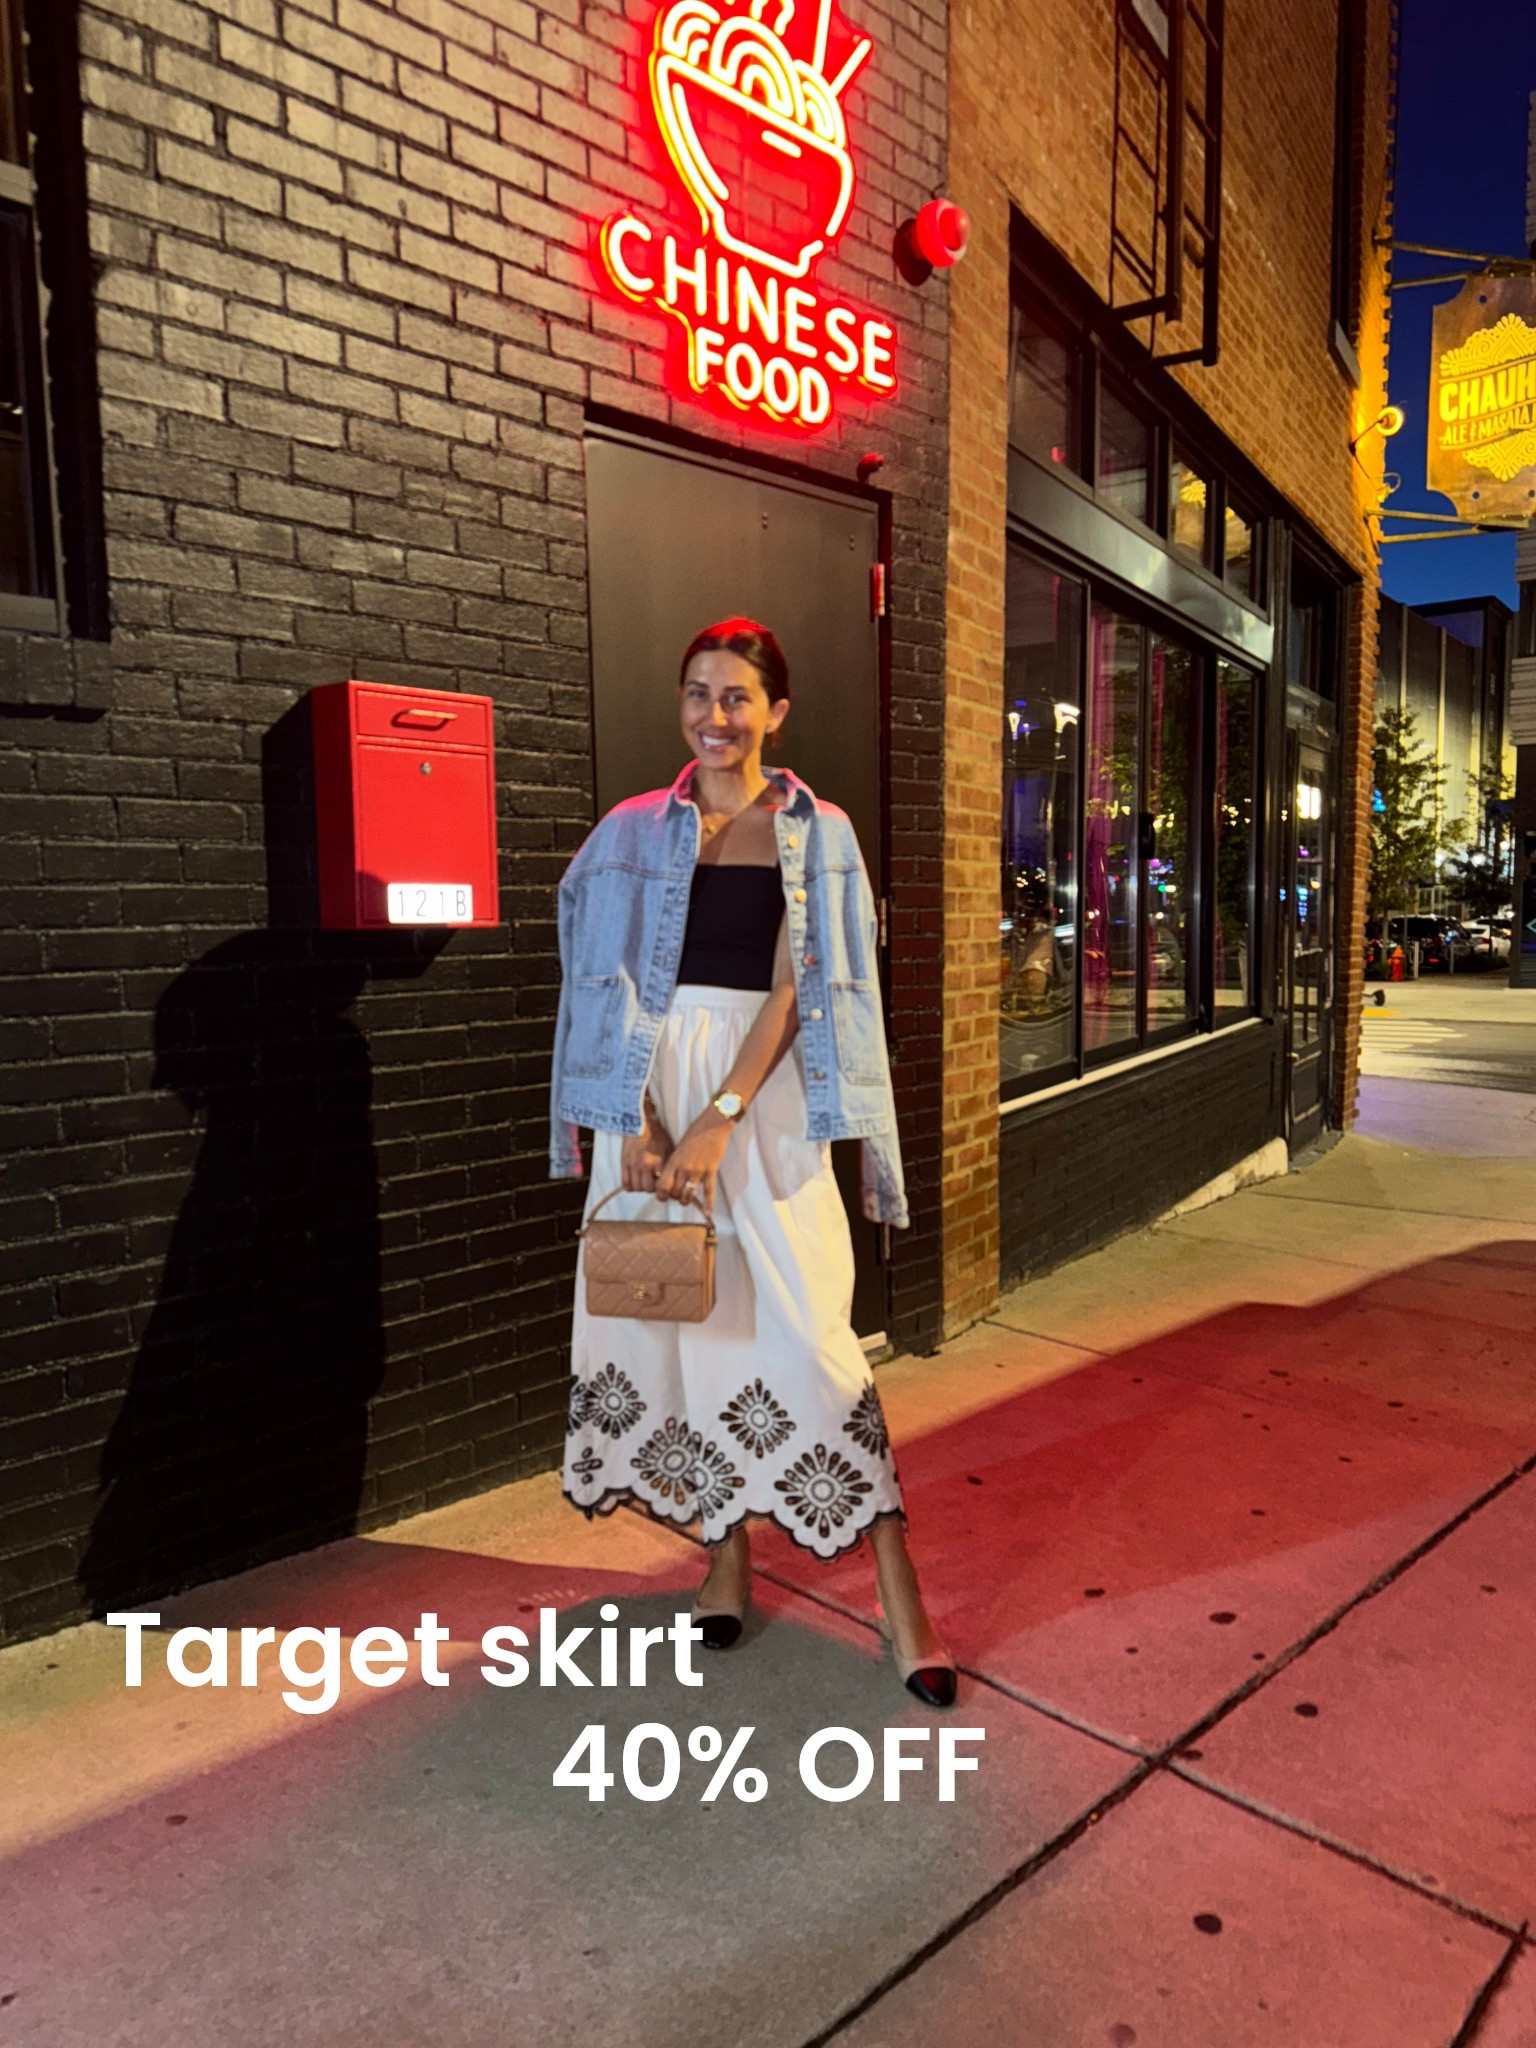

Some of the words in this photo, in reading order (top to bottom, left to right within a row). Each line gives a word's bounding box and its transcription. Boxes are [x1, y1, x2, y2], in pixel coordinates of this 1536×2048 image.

[608, 216, 894, 388] CHINESE
[695, 327, 830, 424] FOOD
[1443, 424, 1467, 444] ALE
[1478, 404, 1531, 440] MASALA
[398, 889, 467, 917] 121B
